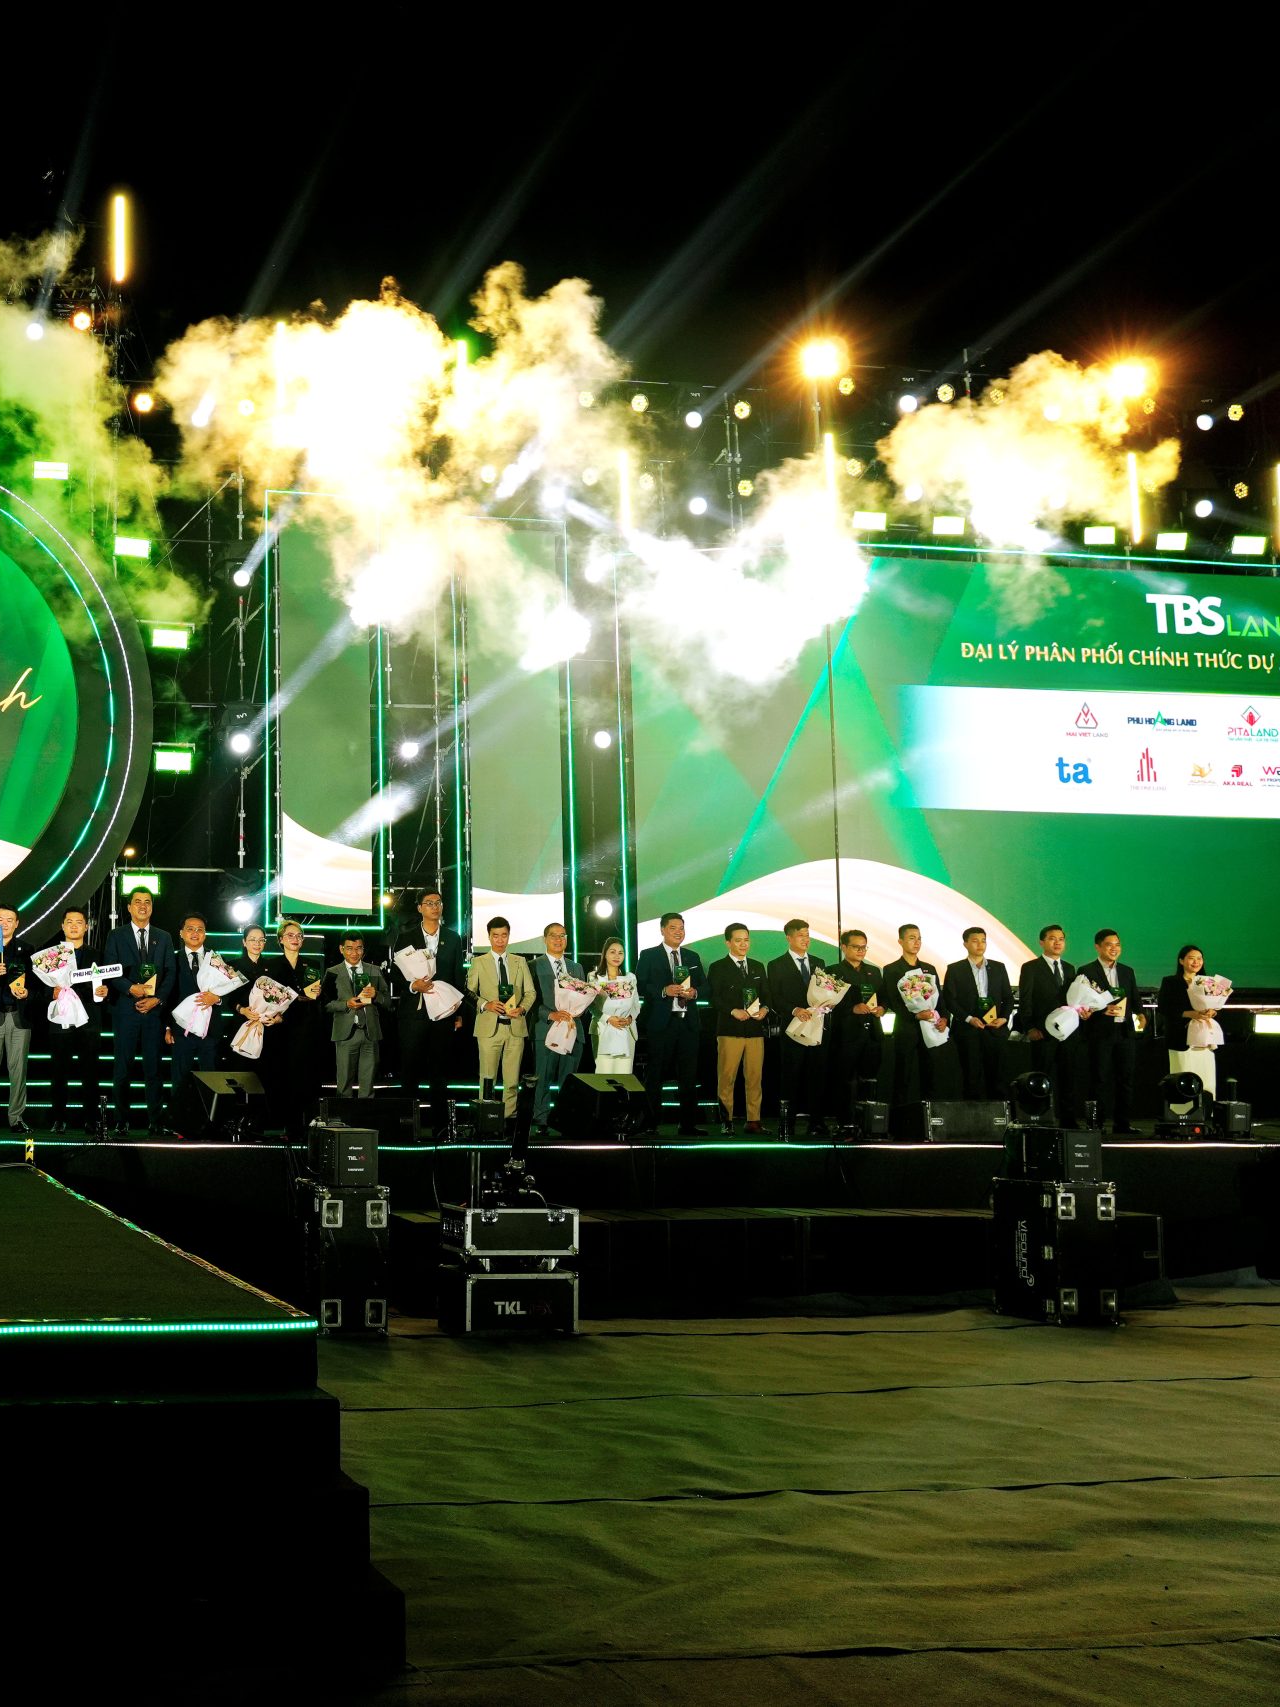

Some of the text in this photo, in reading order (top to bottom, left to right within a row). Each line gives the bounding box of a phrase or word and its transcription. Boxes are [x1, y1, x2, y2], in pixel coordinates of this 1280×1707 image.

[1145, 593, 1225, 636] TBS
[960, 640, 1275, 674] ĐẠI LÝ PHÂN PHỐI CHÍNH THỨC DỰ
[1055, 757, 1093, 784] ta
[493, 1300, 527, 1315] TKL
